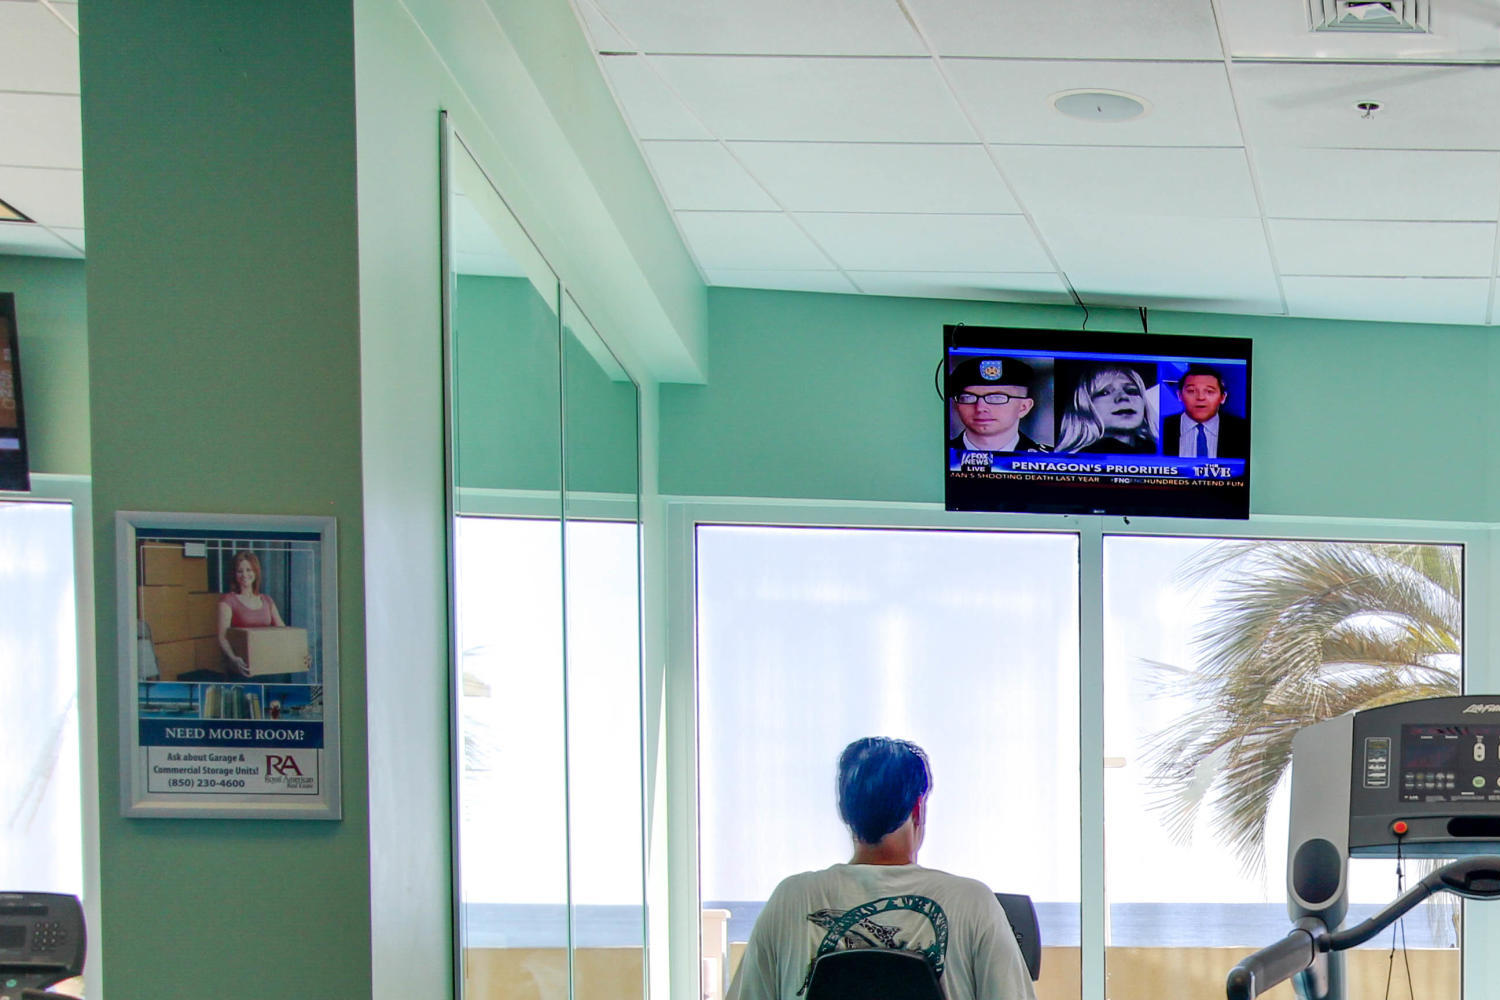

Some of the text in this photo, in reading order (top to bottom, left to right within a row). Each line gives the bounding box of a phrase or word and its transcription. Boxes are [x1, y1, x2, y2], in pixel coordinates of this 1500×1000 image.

[1012, 461, 1178, 475] PENTAGON'S PRIORITIES
[1193, 466, 1231, 478] FIVE
[165, 727, 305, 741] NEED MORE ROOM?
[167, 752, 245, 764] Ask about Garage &
[153, 765, 259, 777] Commercial Storage Units!
[265, 754, 304, 776] RA
[168, 778, 246, 788] (850) 230-4600
